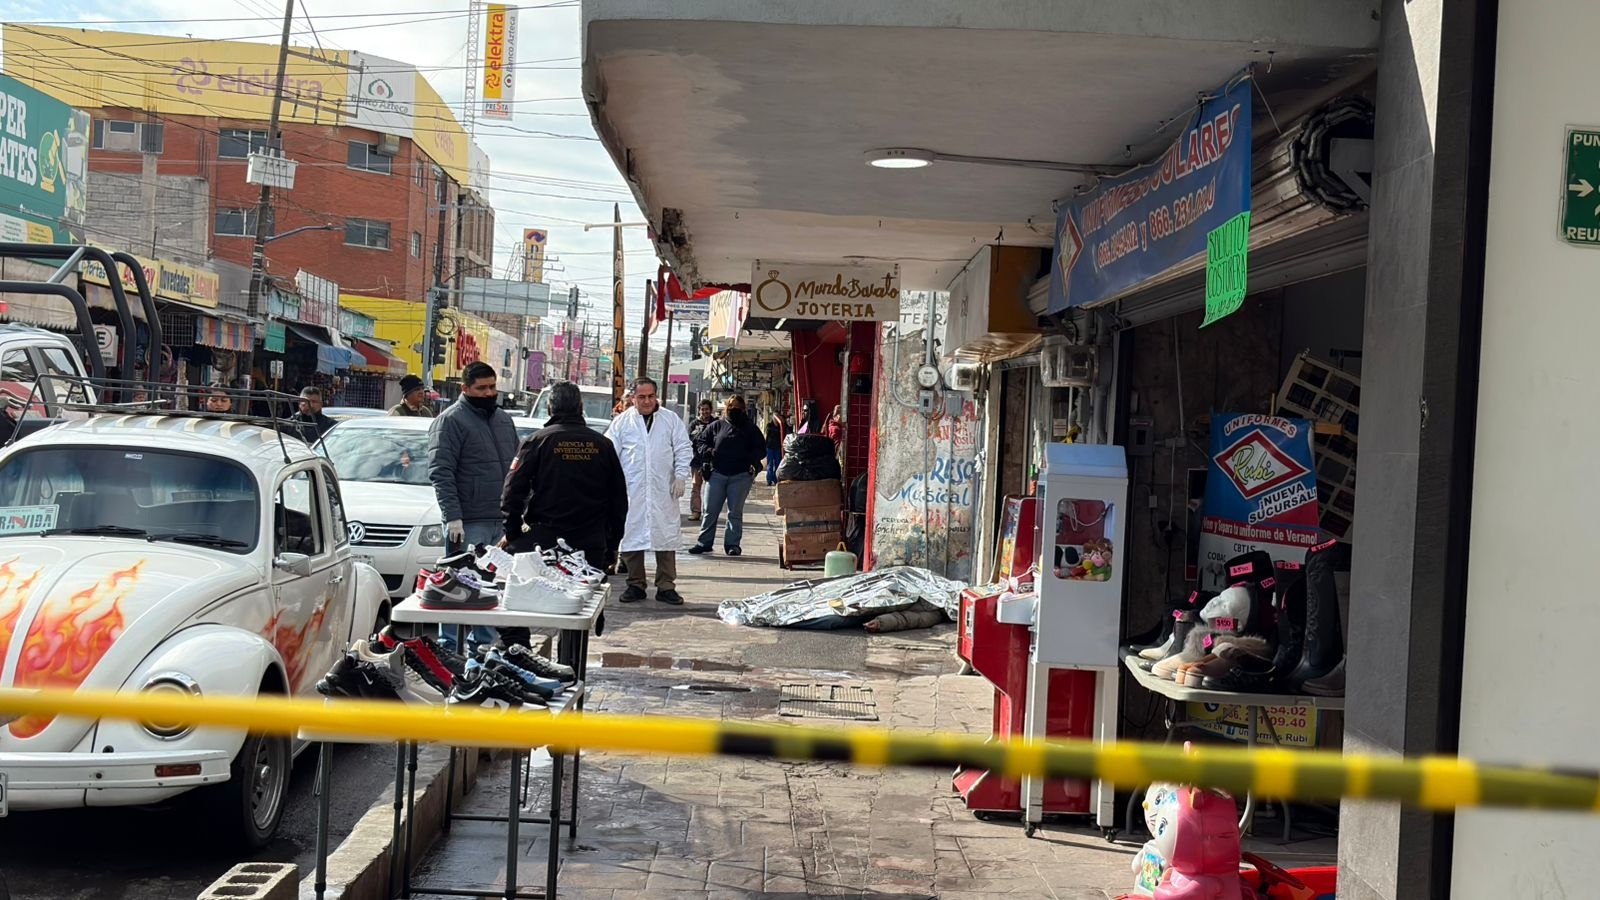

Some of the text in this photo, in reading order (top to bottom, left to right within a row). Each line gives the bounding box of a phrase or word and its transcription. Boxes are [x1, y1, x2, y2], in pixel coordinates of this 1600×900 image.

[487, 13, 504, 70] elektra
[506, 16, 516, 72] Banco Azteca
[217, 66, 324, 100] elektra
[485, 101, 508, 111] PRESTA
[1139, 220, 1148, 252] y
[1208, 214, 1246, 265] SOLICITO
[795, 273, 849, 299] Mundo
[1207, 253, 1246, 299] COSTURERA
[797, 302, 875, 318] JOYERIA
[1224, 414, 1297, 438] UNIFORMES
[1248, 487, 1317, 525] SUCURSAL!
[1259, 481, 1306, 511] ¡NUEVA
[22, 514, 52, 529] VIDA
[1218, 519, 1233, 535] Separa
[1239, 524, 1272, 540] uniforme
[1273, 528, 1284, 541] de
[1285, 732, 1308, 743] Rubi
